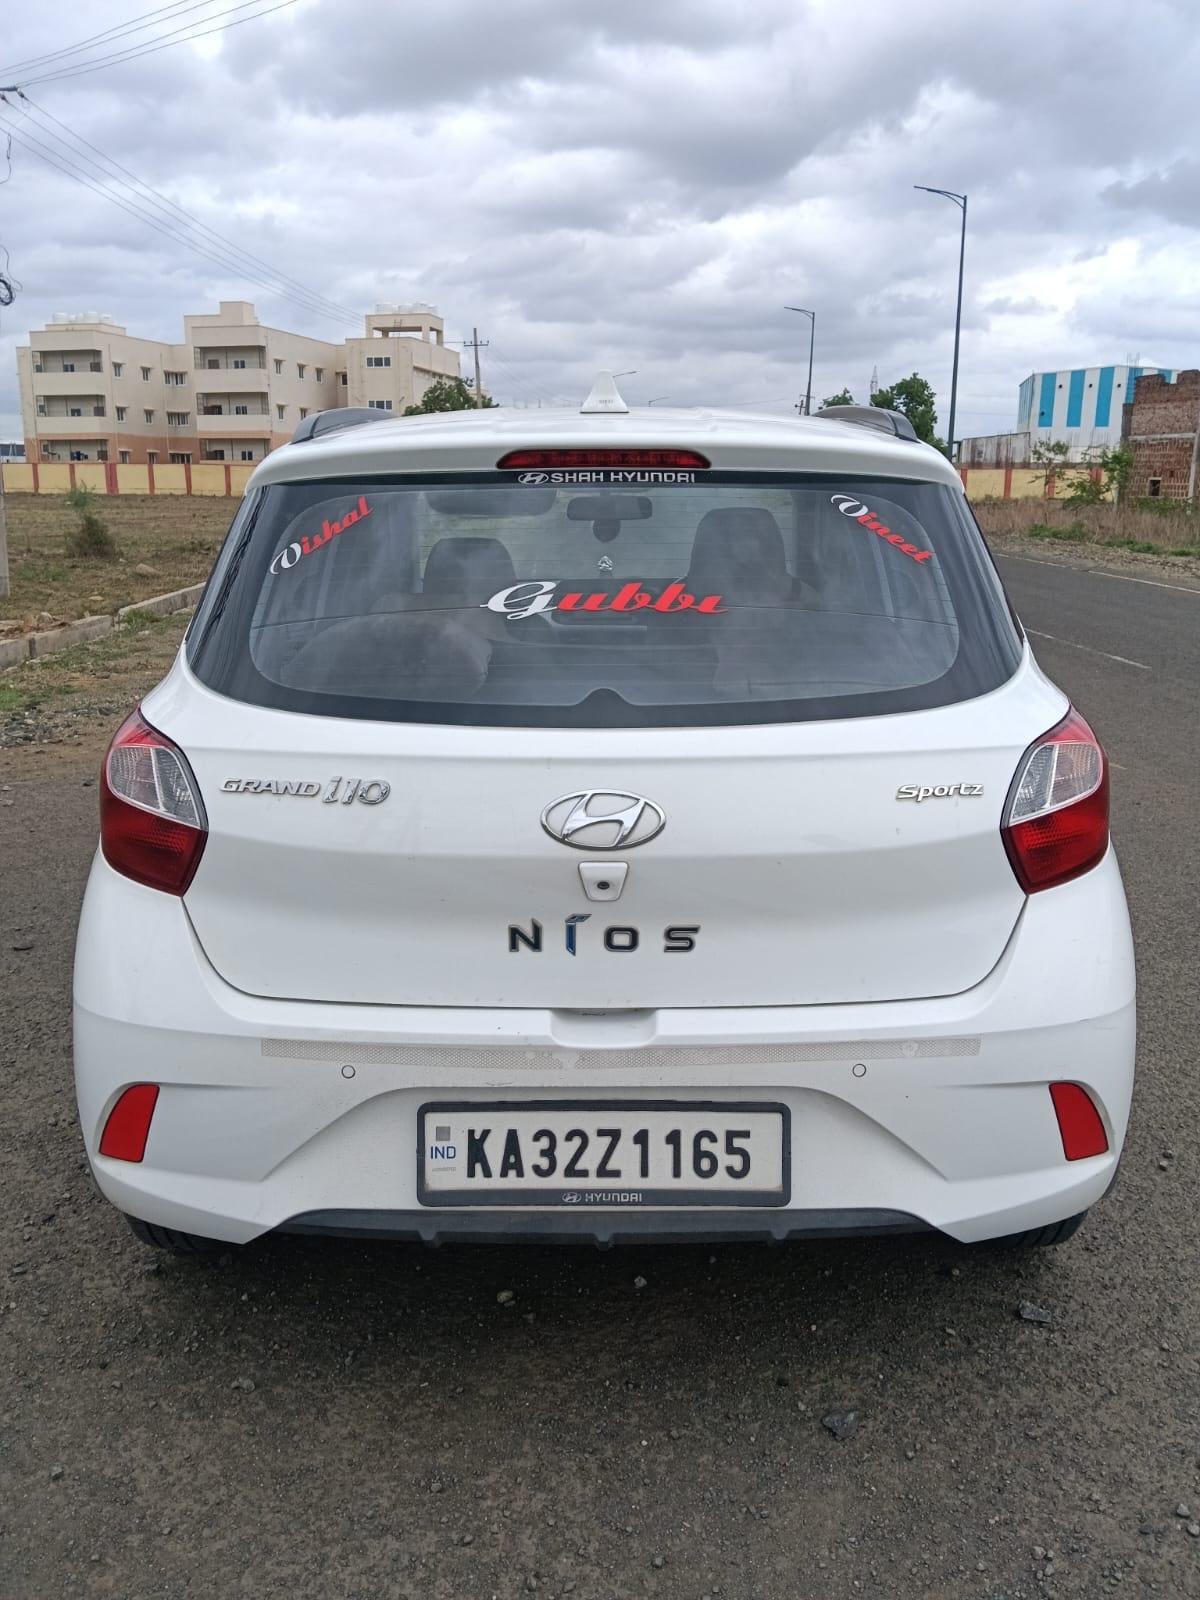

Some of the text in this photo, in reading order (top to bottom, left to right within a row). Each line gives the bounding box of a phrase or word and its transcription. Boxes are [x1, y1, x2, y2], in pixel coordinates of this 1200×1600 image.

[551, 472, 695, 483] SHAH HYUNDAI
[270, 497, 374, 574] Vishal
[831, 495, 932, 565] Vineet
[480, 581, 729, 620] Gubbi
[220, 778, 321, 796] GRAND
[896, 783, 984, 802] Sportz
[430, 1145, 456, 1159] IND
[467, 1128, 751, 1179] KA32Z1165
[585, 1192, 642, 1202] HYUNDAI
